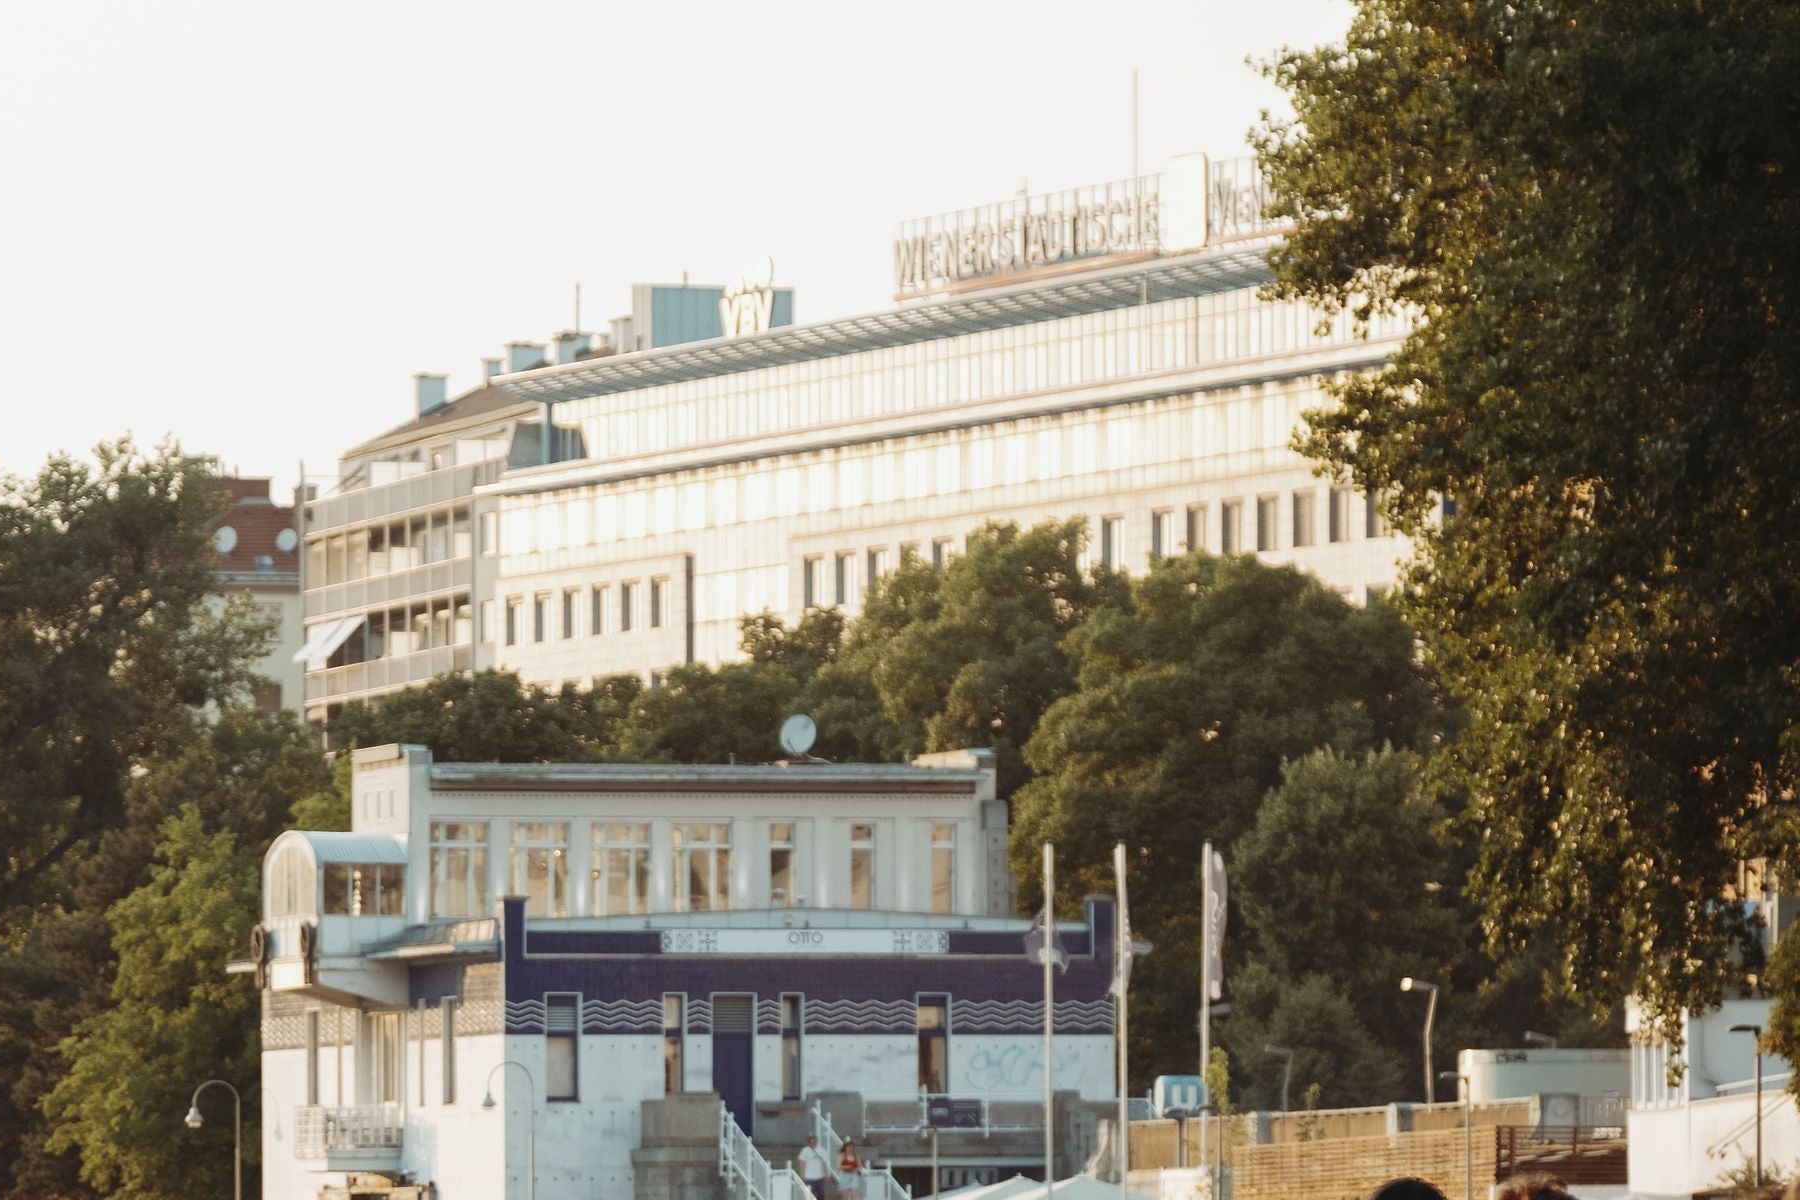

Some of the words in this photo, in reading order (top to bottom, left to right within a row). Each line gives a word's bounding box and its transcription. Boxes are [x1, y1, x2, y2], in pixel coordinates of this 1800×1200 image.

[894, 222, 993, 283] WIENER
[788, 931, 823, 944] OTTO
[1172, 1084, 1197, 1110] U
